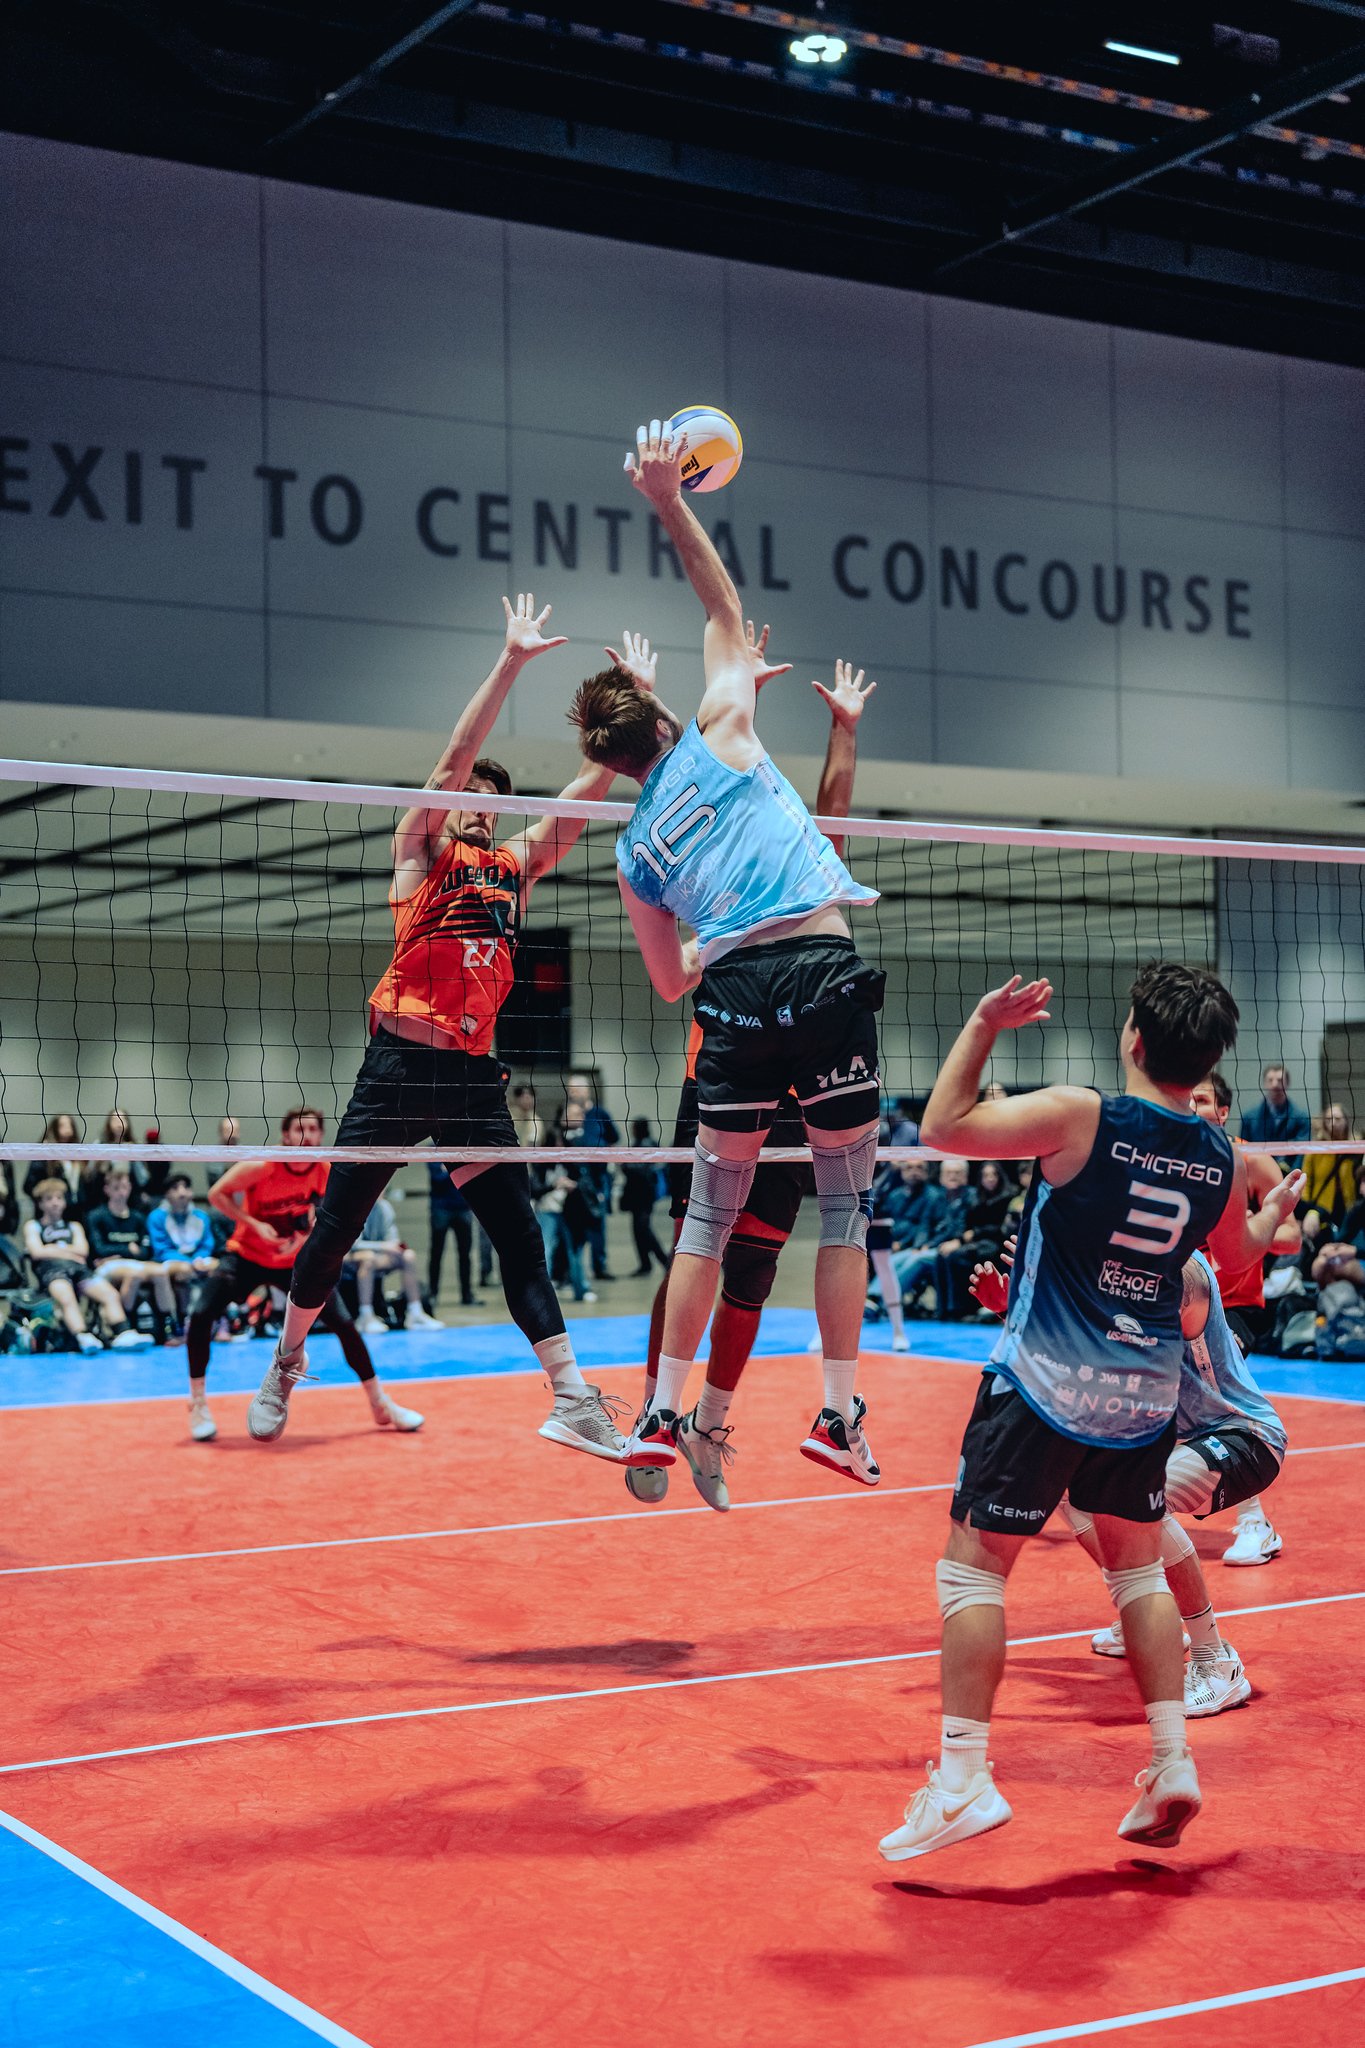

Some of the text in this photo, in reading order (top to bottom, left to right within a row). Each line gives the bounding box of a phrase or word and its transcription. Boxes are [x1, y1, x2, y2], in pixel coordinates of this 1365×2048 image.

[0, 437, 206, 529] EXIT
[255, 465, 363, 545] TO
[833, 534, 1252, 639] CONCOURSE
[631, 782, 718, 886] 16
[463, 939, 498, 968] 27
[733, 1014, 763, 1029] JVA
[1110, 1140, 1223, 1187] CHICAGO
[1108, 1180, 1191, 1256] 3
[1106, 1259, 1124, 1270] THE
[1102, 1269, 1157, 1294] KEHOE
[1108, 1288, 1144, 1302] GROUP
[1099, 1371, 1121, 1385] JVA
[988, 1502, 1047, 1522] ICEMEN
